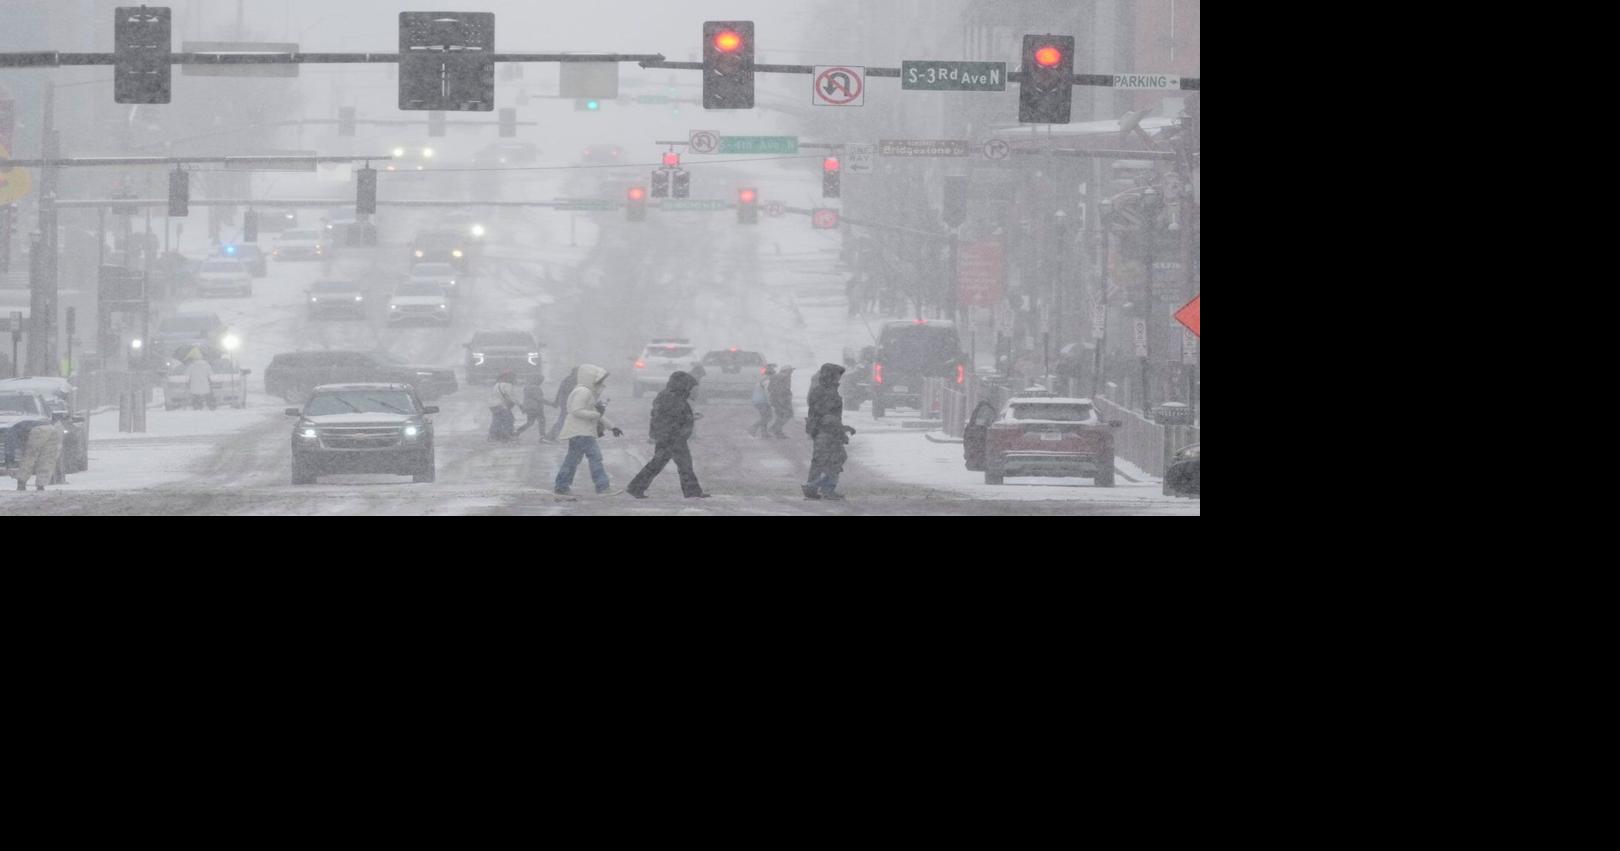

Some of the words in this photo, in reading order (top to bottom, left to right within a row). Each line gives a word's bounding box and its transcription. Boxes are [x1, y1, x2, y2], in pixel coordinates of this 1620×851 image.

[961, 73, 987, 84] Ave
[990, 69, 999, 84] N
[1114, 75, 1167, 88] PARKING
[883, 145, 952, 156] Bridgestone
[849, 154, 870, 162] WAY
